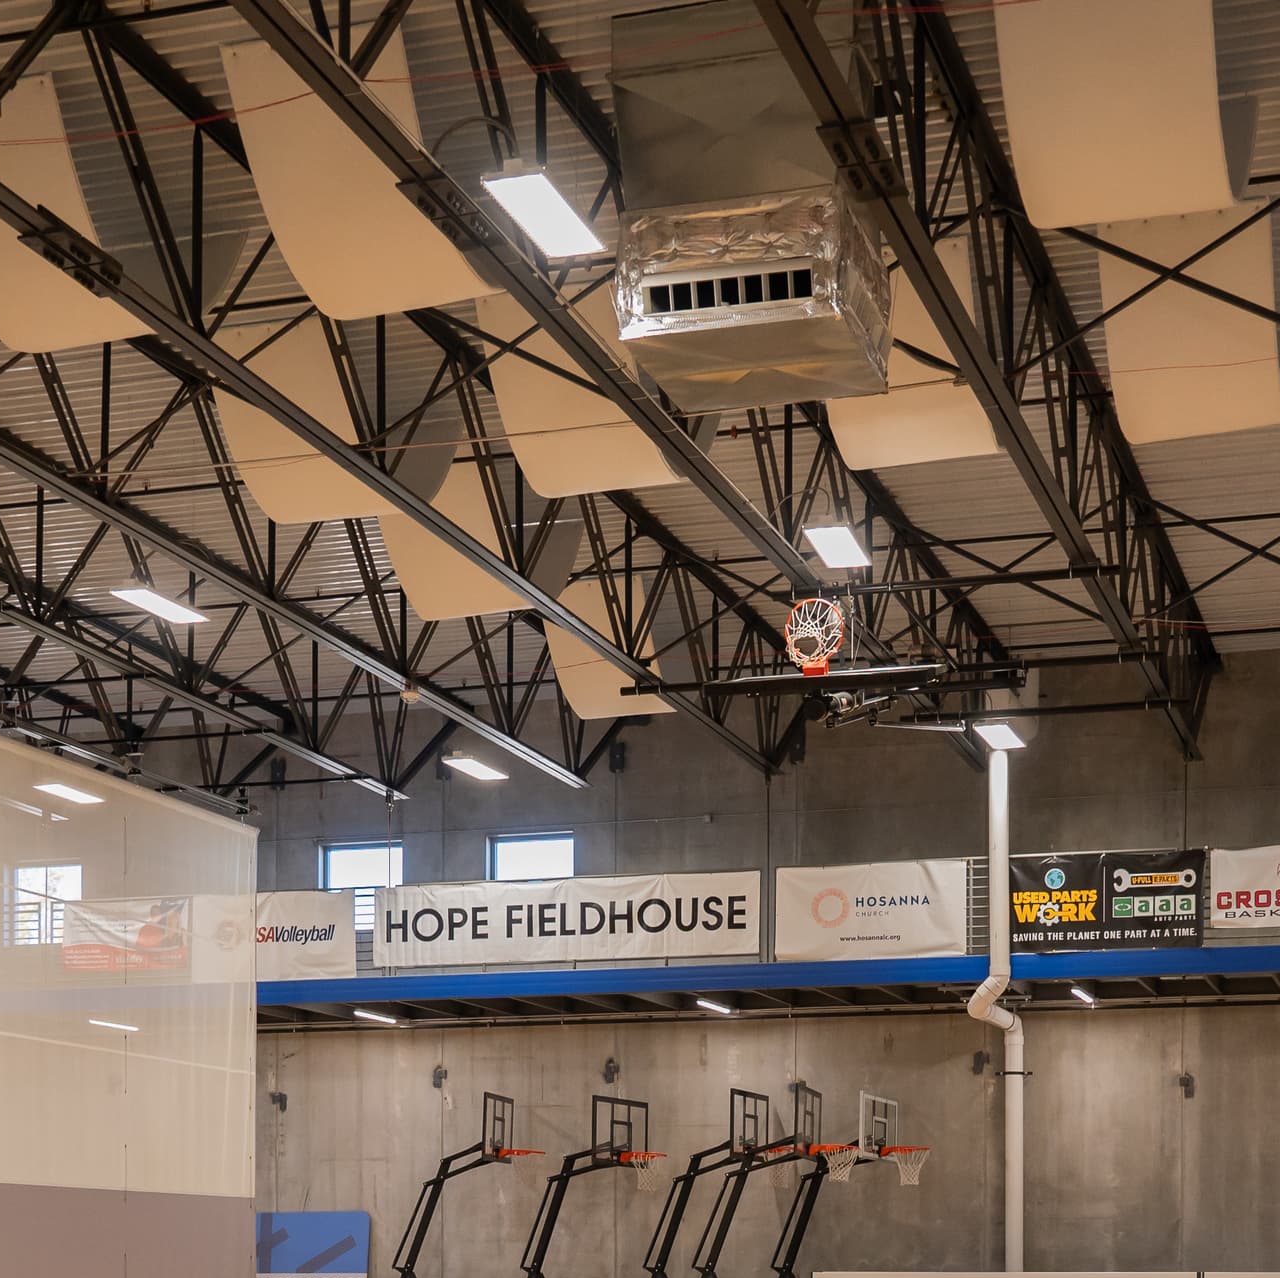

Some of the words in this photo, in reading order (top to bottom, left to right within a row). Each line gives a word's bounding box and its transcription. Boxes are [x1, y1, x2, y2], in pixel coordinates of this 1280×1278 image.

[855, 895, 930, 907] HOSANNA
[1013, 891, 1050, 904] USED
[1052, 890, 1097, 903] PARTS
[386, 906, 489, 943] HOPE
[506, 895, 747, 938] FIELDHOUSE
[256, 924, 335, 945] SAVolleyball
[1013, 933, 1043, 942] SAVING
[1047, 932, 1064, 941] THE
[1067, 931, 1101, 940] PLANET
[1104, 931, 1121, 939] ONE
[1125, 930, 1148, 938] PART
[1150, 929, 1161, 937] AT
[1164, 929, 1170, 937] A
[1173, 928, 1197, 937] TIME.
